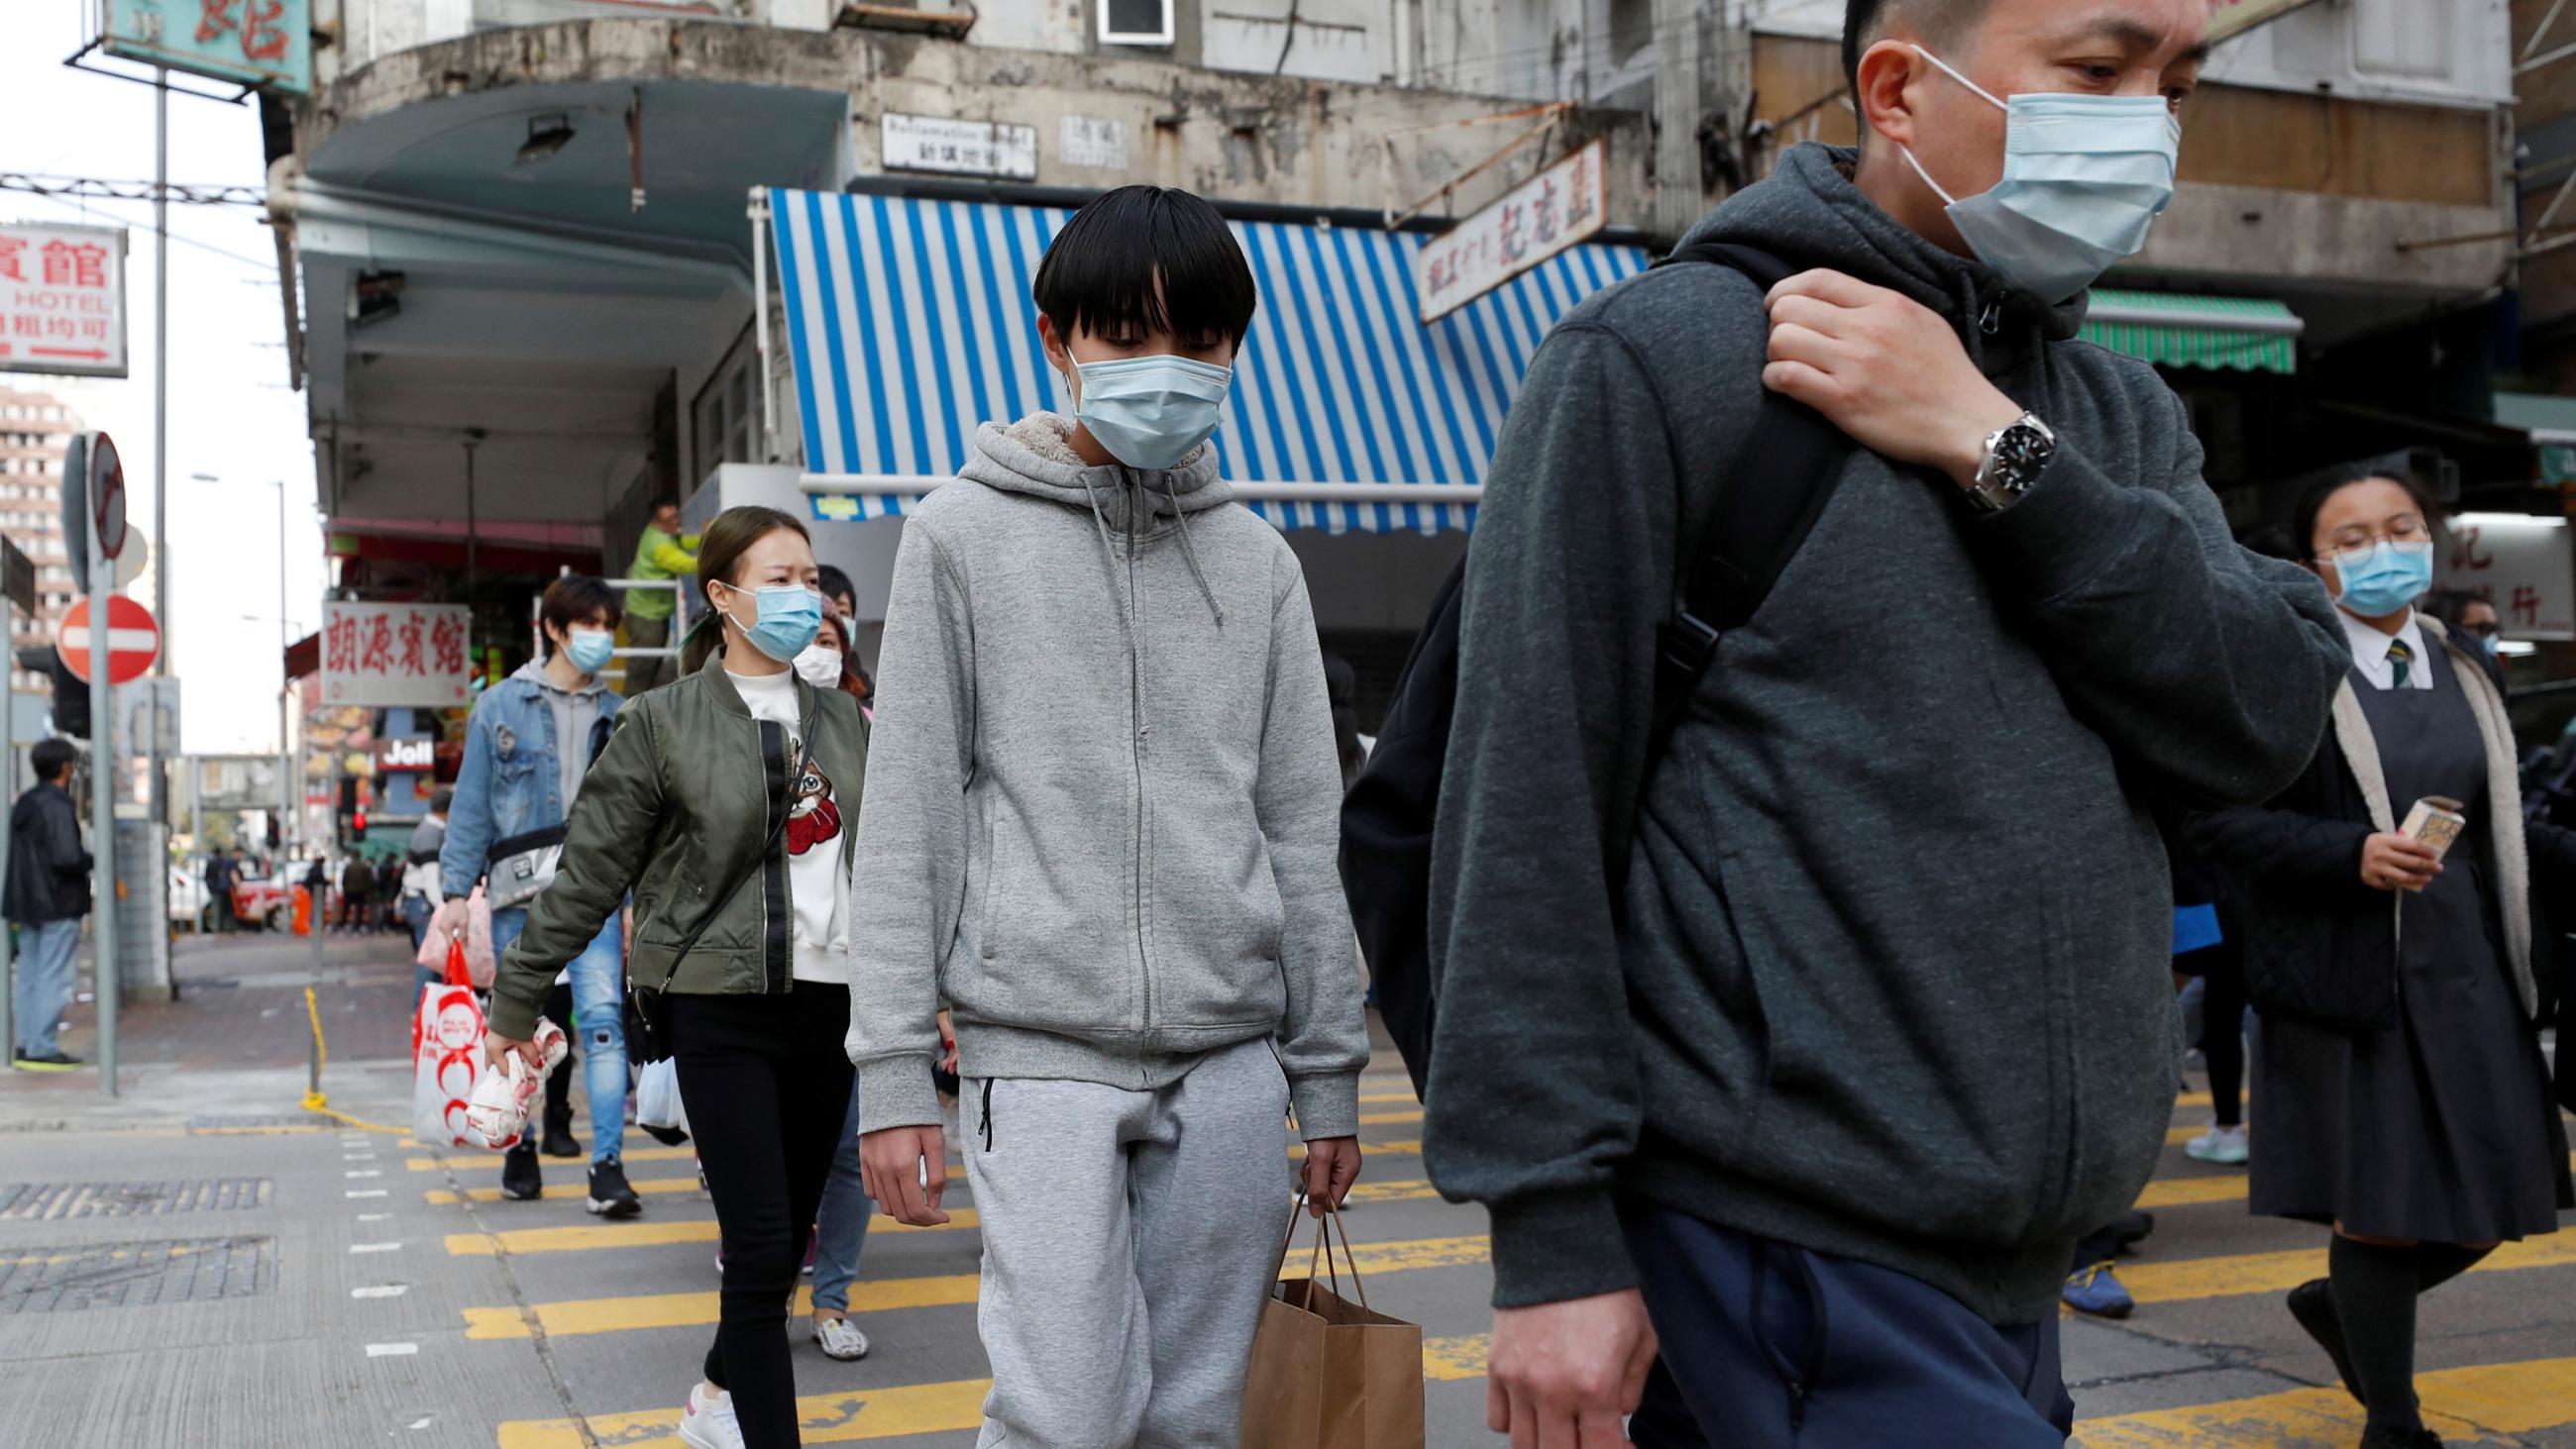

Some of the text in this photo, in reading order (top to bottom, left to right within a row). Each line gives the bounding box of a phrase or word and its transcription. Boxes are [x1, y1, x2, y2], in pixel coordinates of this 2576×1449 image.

[15, 290, 111, 314] HOTEL
[0, 315, 107, 341] 租均可
[325, 609, 466, 677] 朗源賓館
